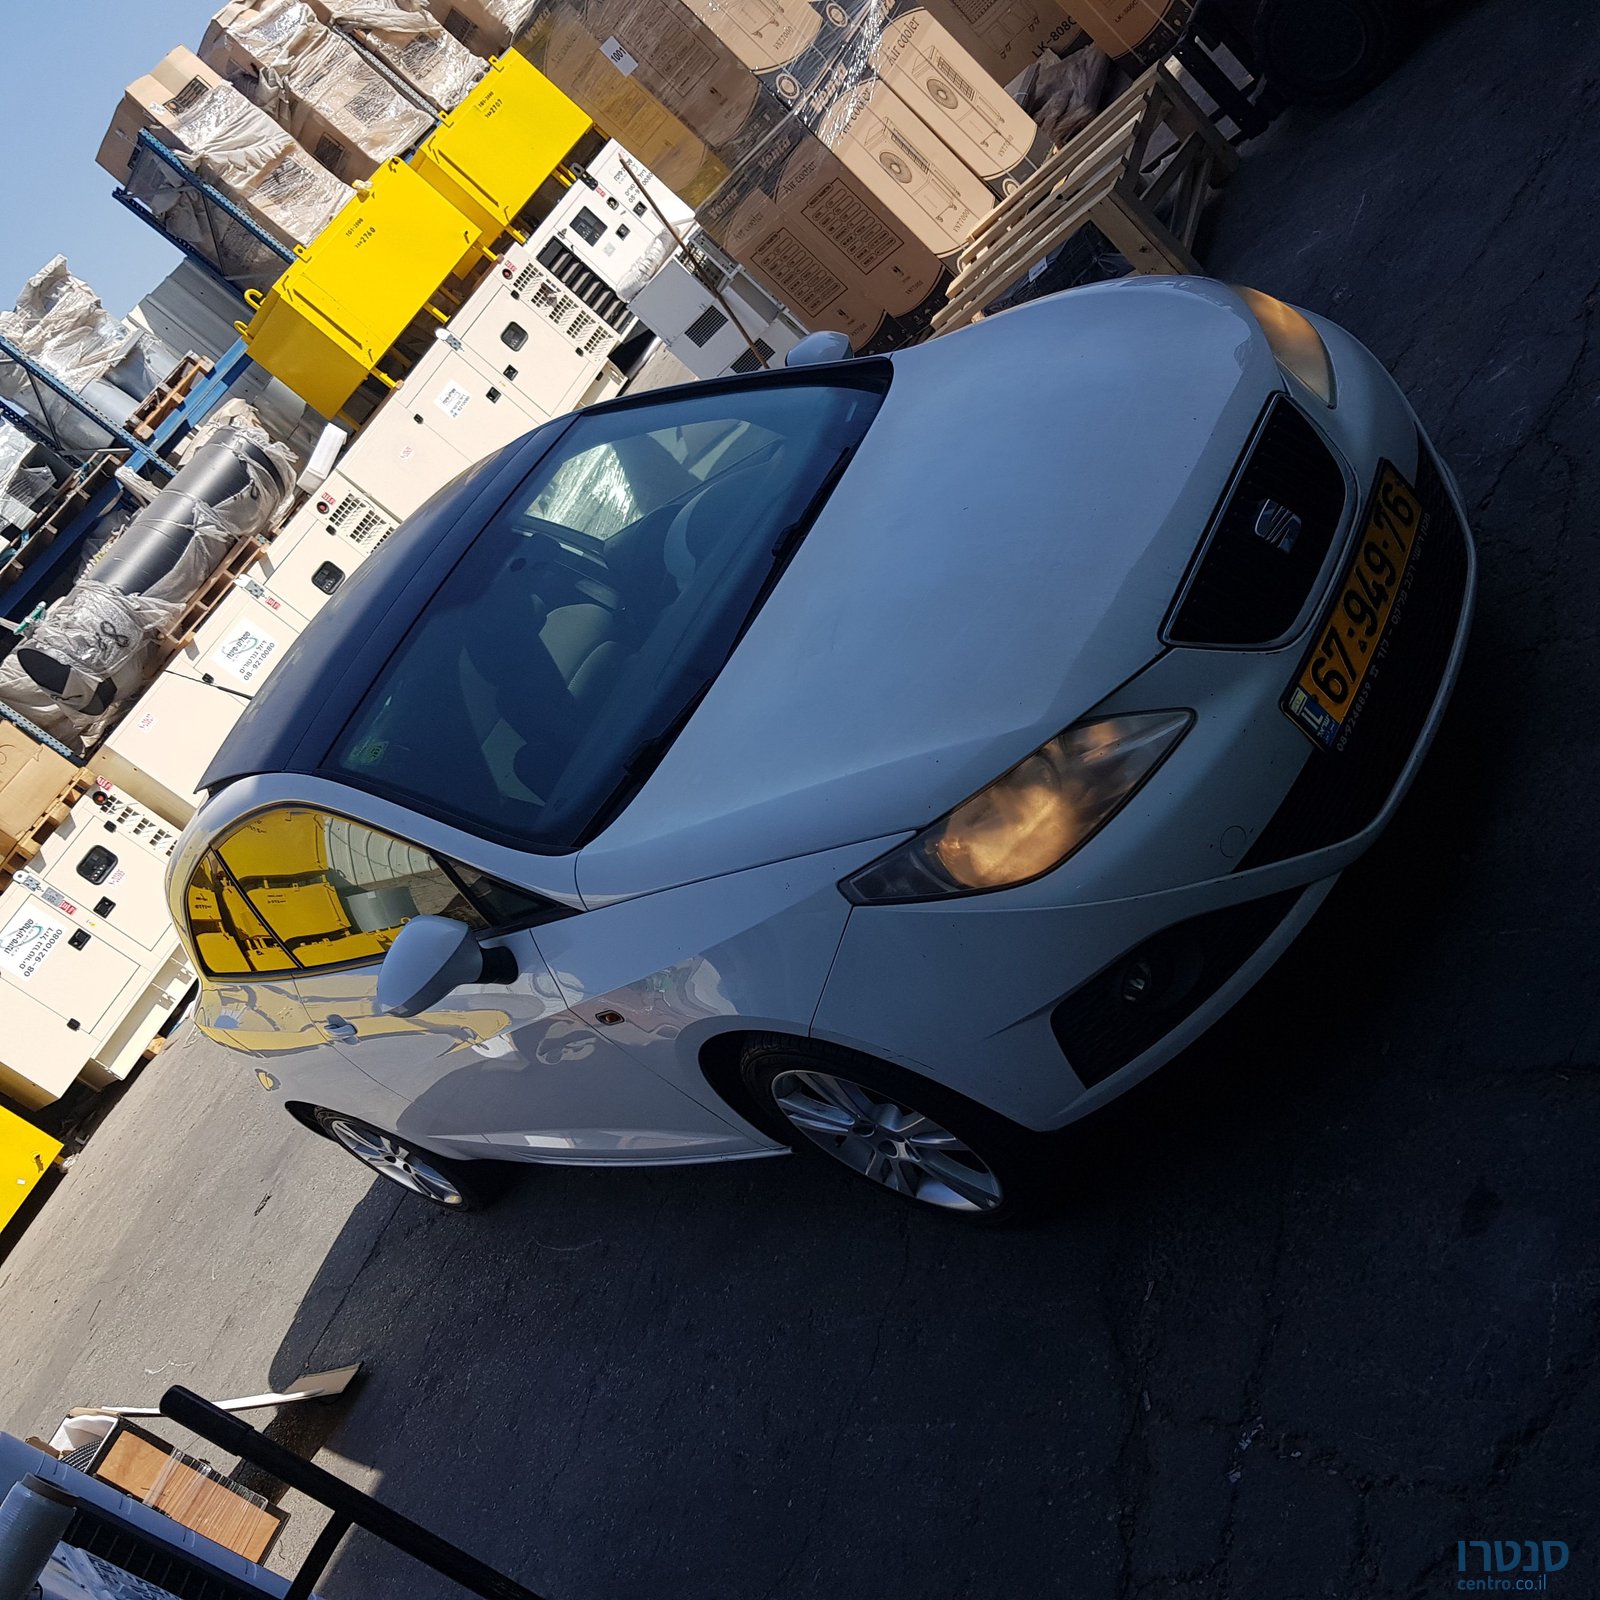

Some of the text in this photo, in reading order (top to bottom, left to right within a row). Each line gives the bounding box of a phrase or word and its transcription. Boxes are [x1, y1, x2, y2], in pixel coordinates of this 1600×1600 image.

[610, 46, 627, 64] 1001
[887, 16, 921, 67] Air cooler
[757, 135, 792, 170] Venta
[782, 178, 798, 195] Air
[793, 158, 818, 185] cooler
[708, 186, 740, 220] Venta
[731, 208, 765, 243] Air cooler
[1404, 563, 1418, 590] רכב
[243, 641, 276, 682] 08-9210080
[255, 638, 267, 651] דיזל
[1301, 708, 1324, 731] IL
[40, 925, 53, 941] דיזל
[18, 939, 43, 970] גנרטורים
[22, 927, 63, 978] 08-9210080
